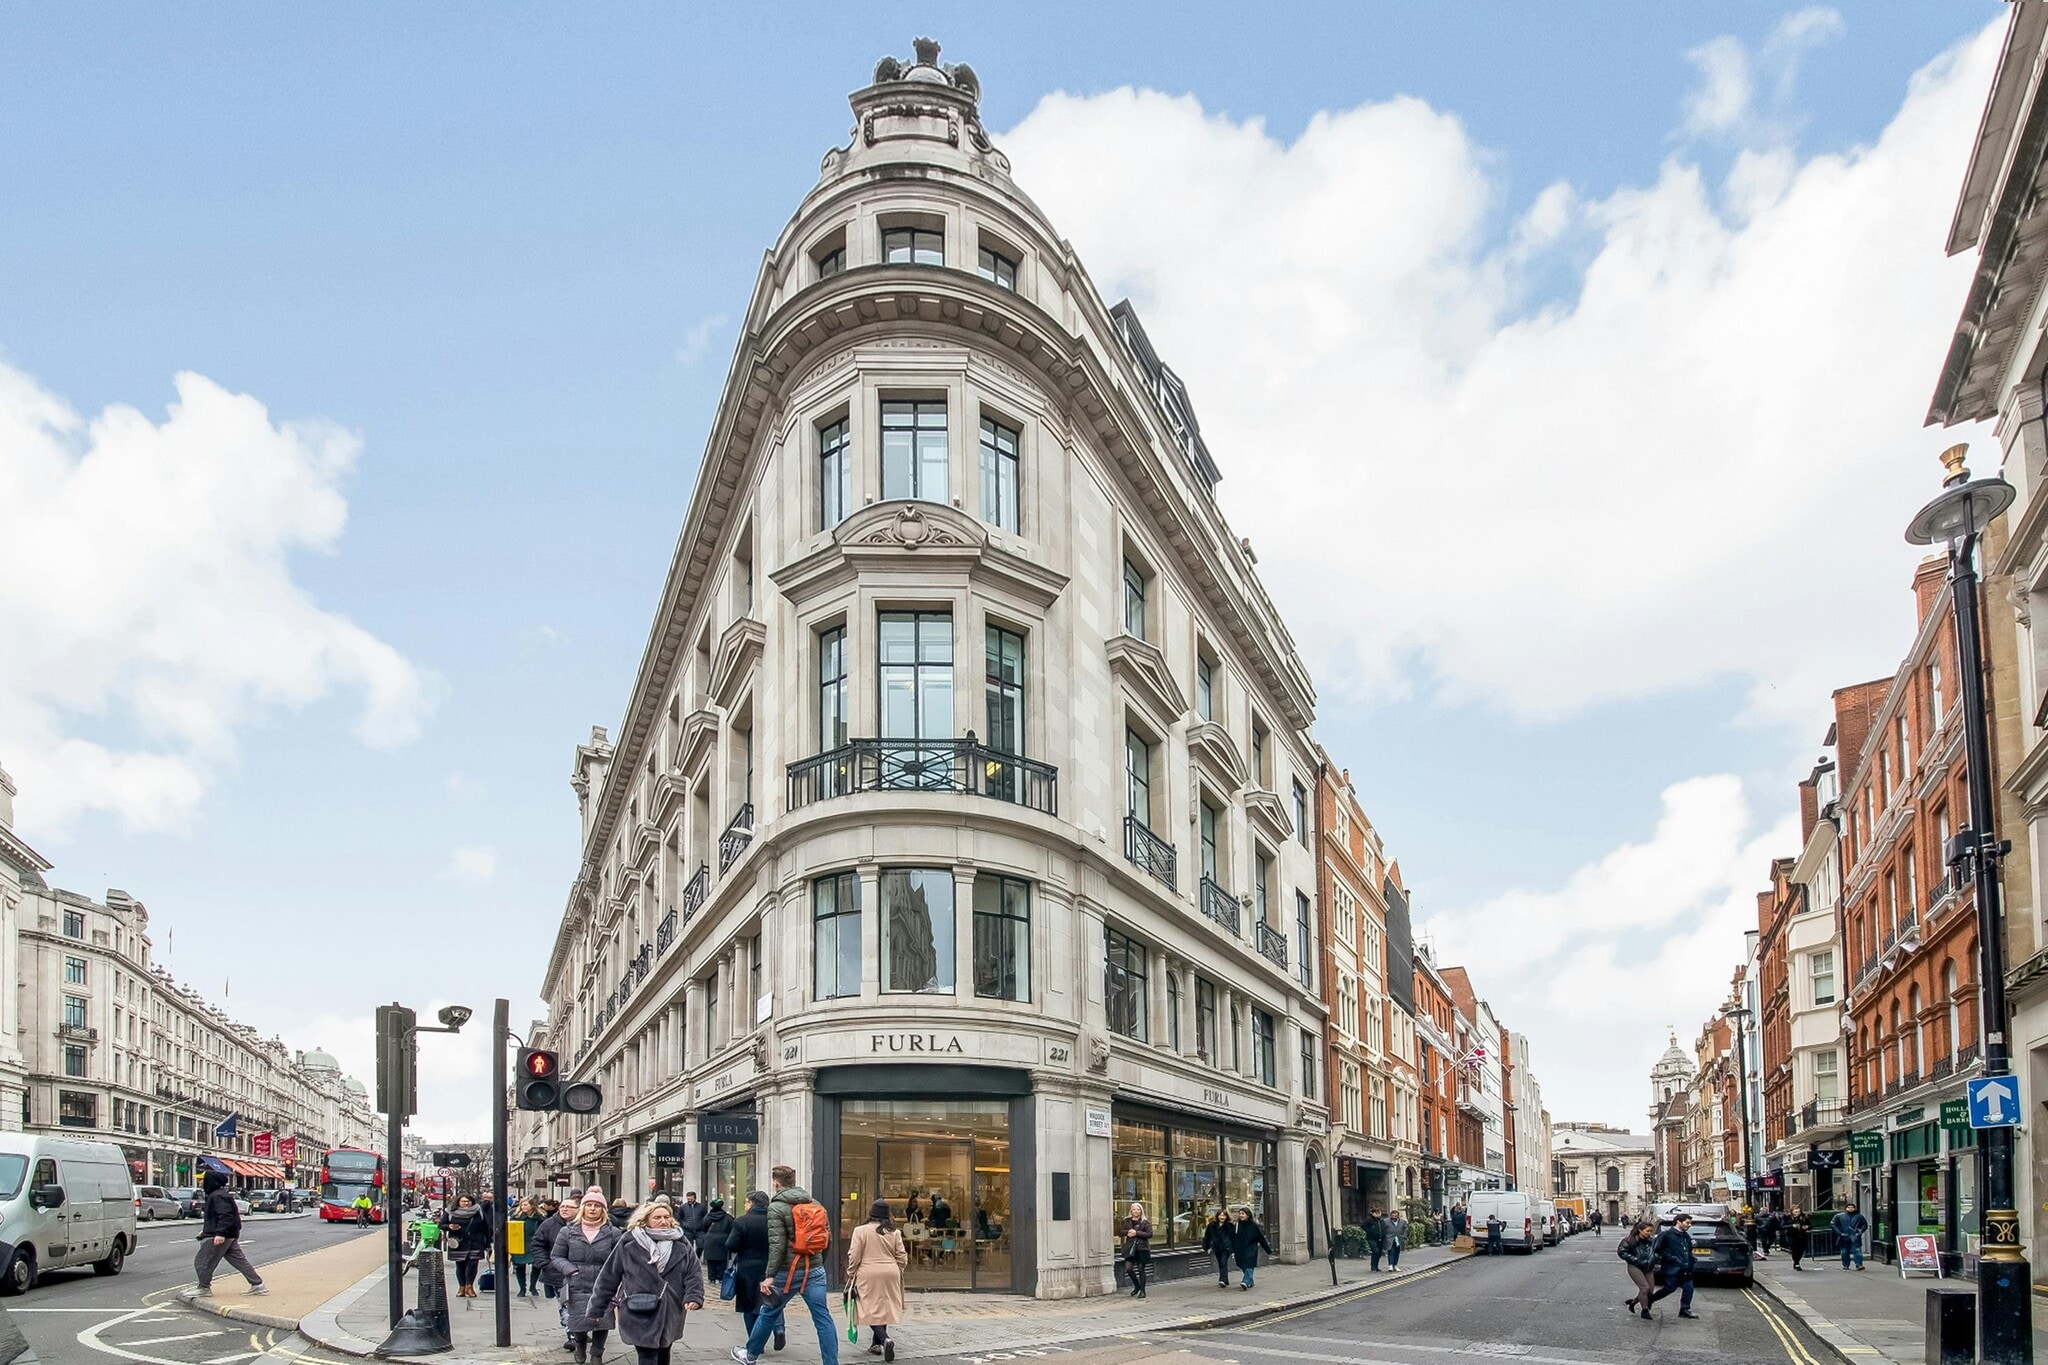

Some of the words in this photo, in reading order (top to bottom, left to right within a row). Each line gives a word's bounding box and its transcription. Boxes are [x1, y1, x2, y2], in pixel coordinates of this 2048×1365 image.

[871, 1034, 964, 1052] FURLA
[784, 1045, 798, 1060] 221
[1049, 1047, 1068, 1062] 221
[1204, 1088, 1230, 1107] FURLA
[704, 1124, 752, 1136] FURLA
[1089, 1120, 1103, 1128] STREET
